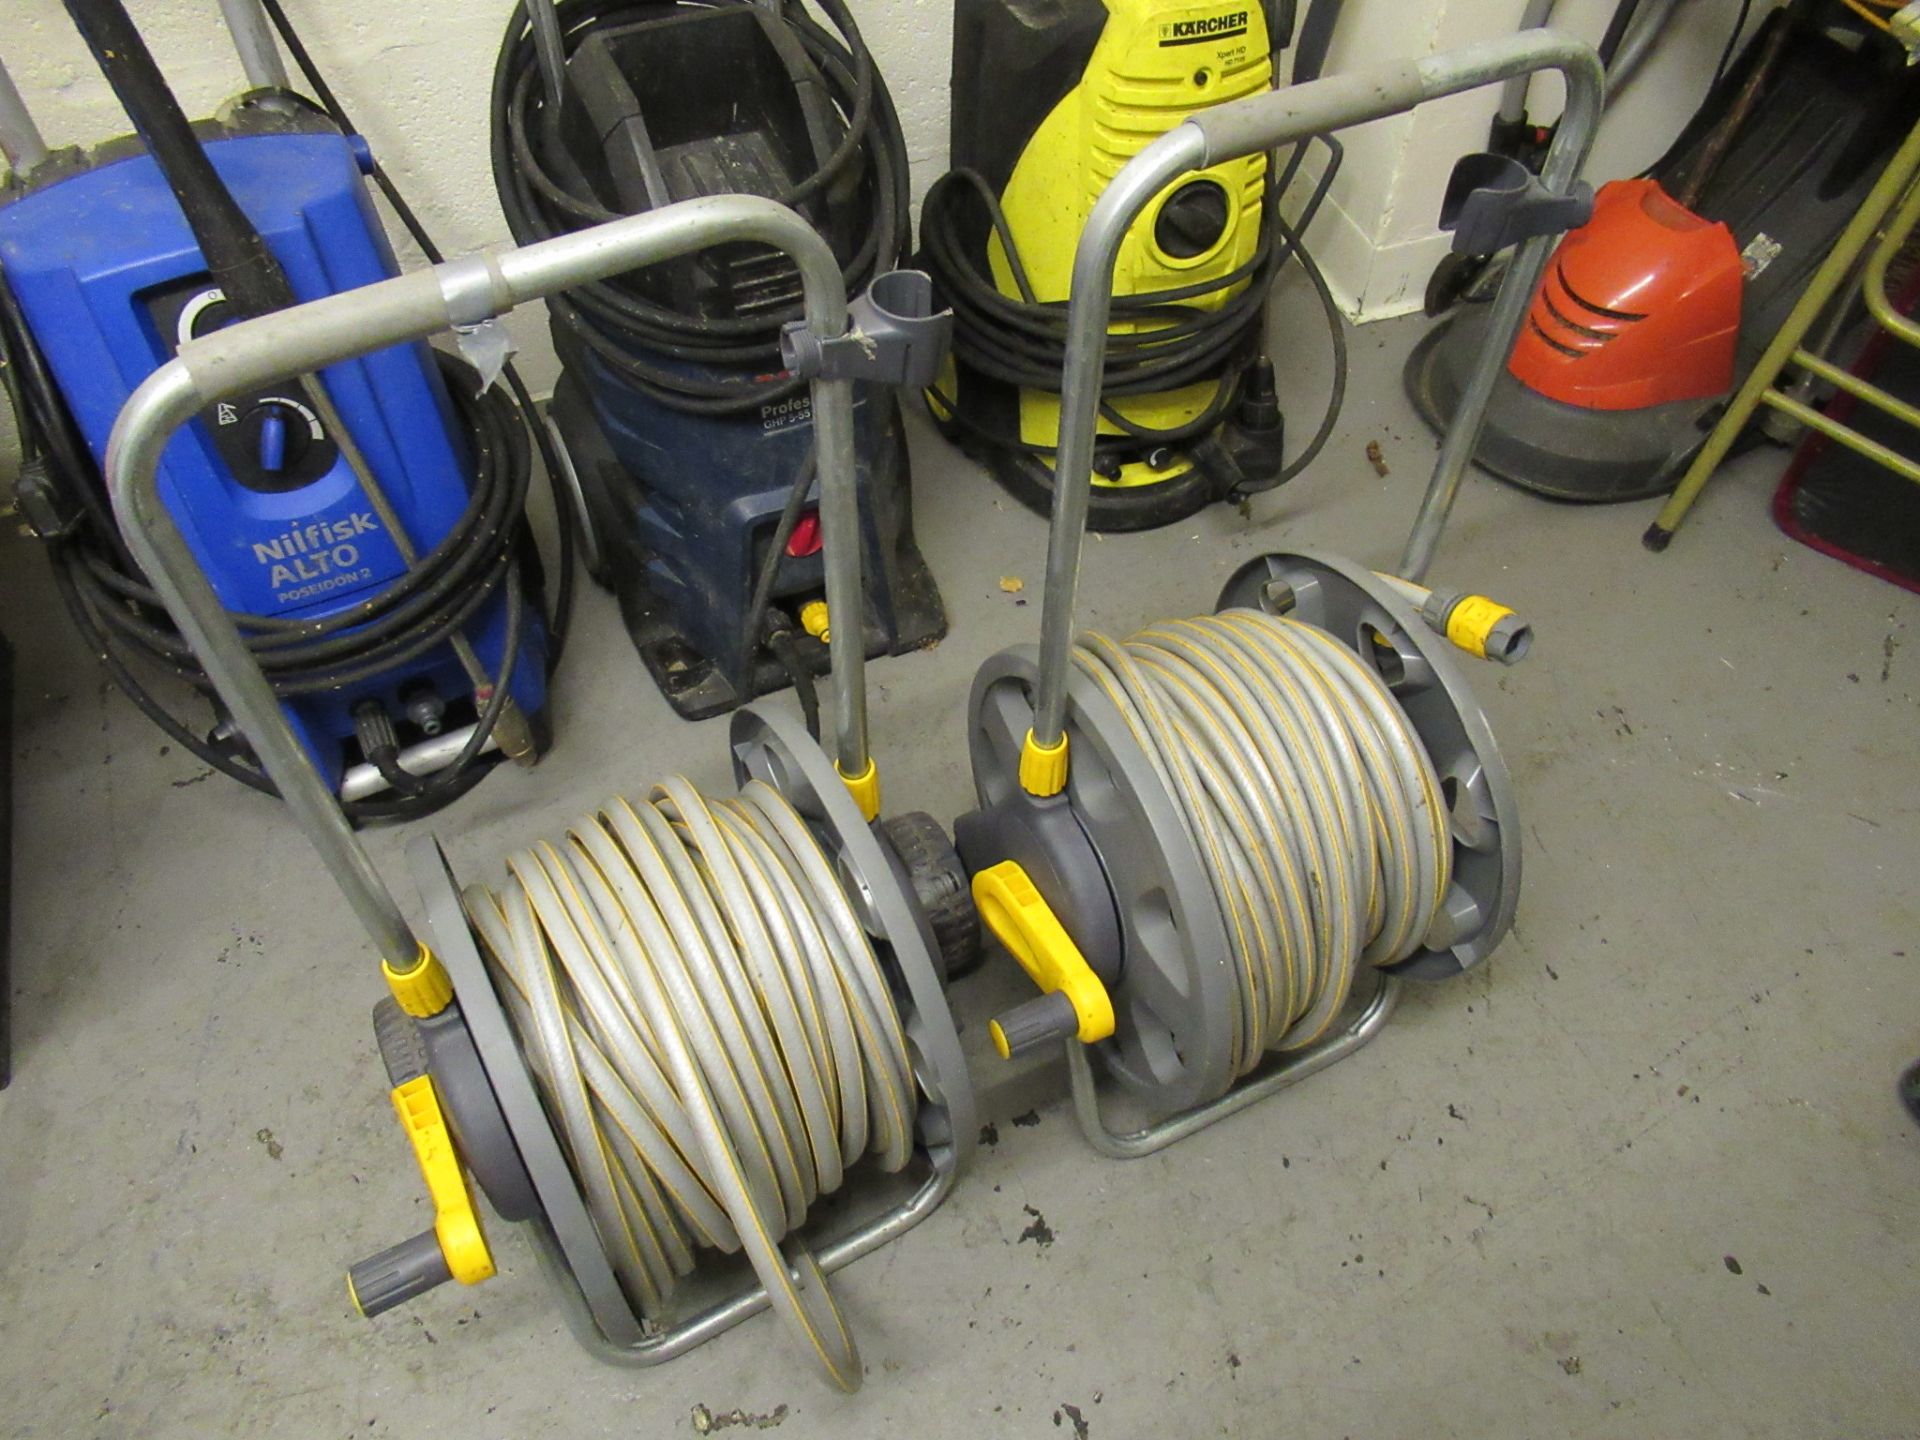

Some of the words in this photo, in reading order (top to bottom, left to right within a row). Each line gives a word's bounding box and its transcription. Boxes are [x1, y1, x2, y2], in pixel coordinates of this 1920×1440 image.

[1236, 46, 1247, 55] HD
[763, 416, 786, 429] GHP
[253, 512, 379, 564] Nilfisk
[271, 543, 359, 589] ALTO
[278, 571, 359, 604] POSEIDON
[360, 567, 373, 578] 2
